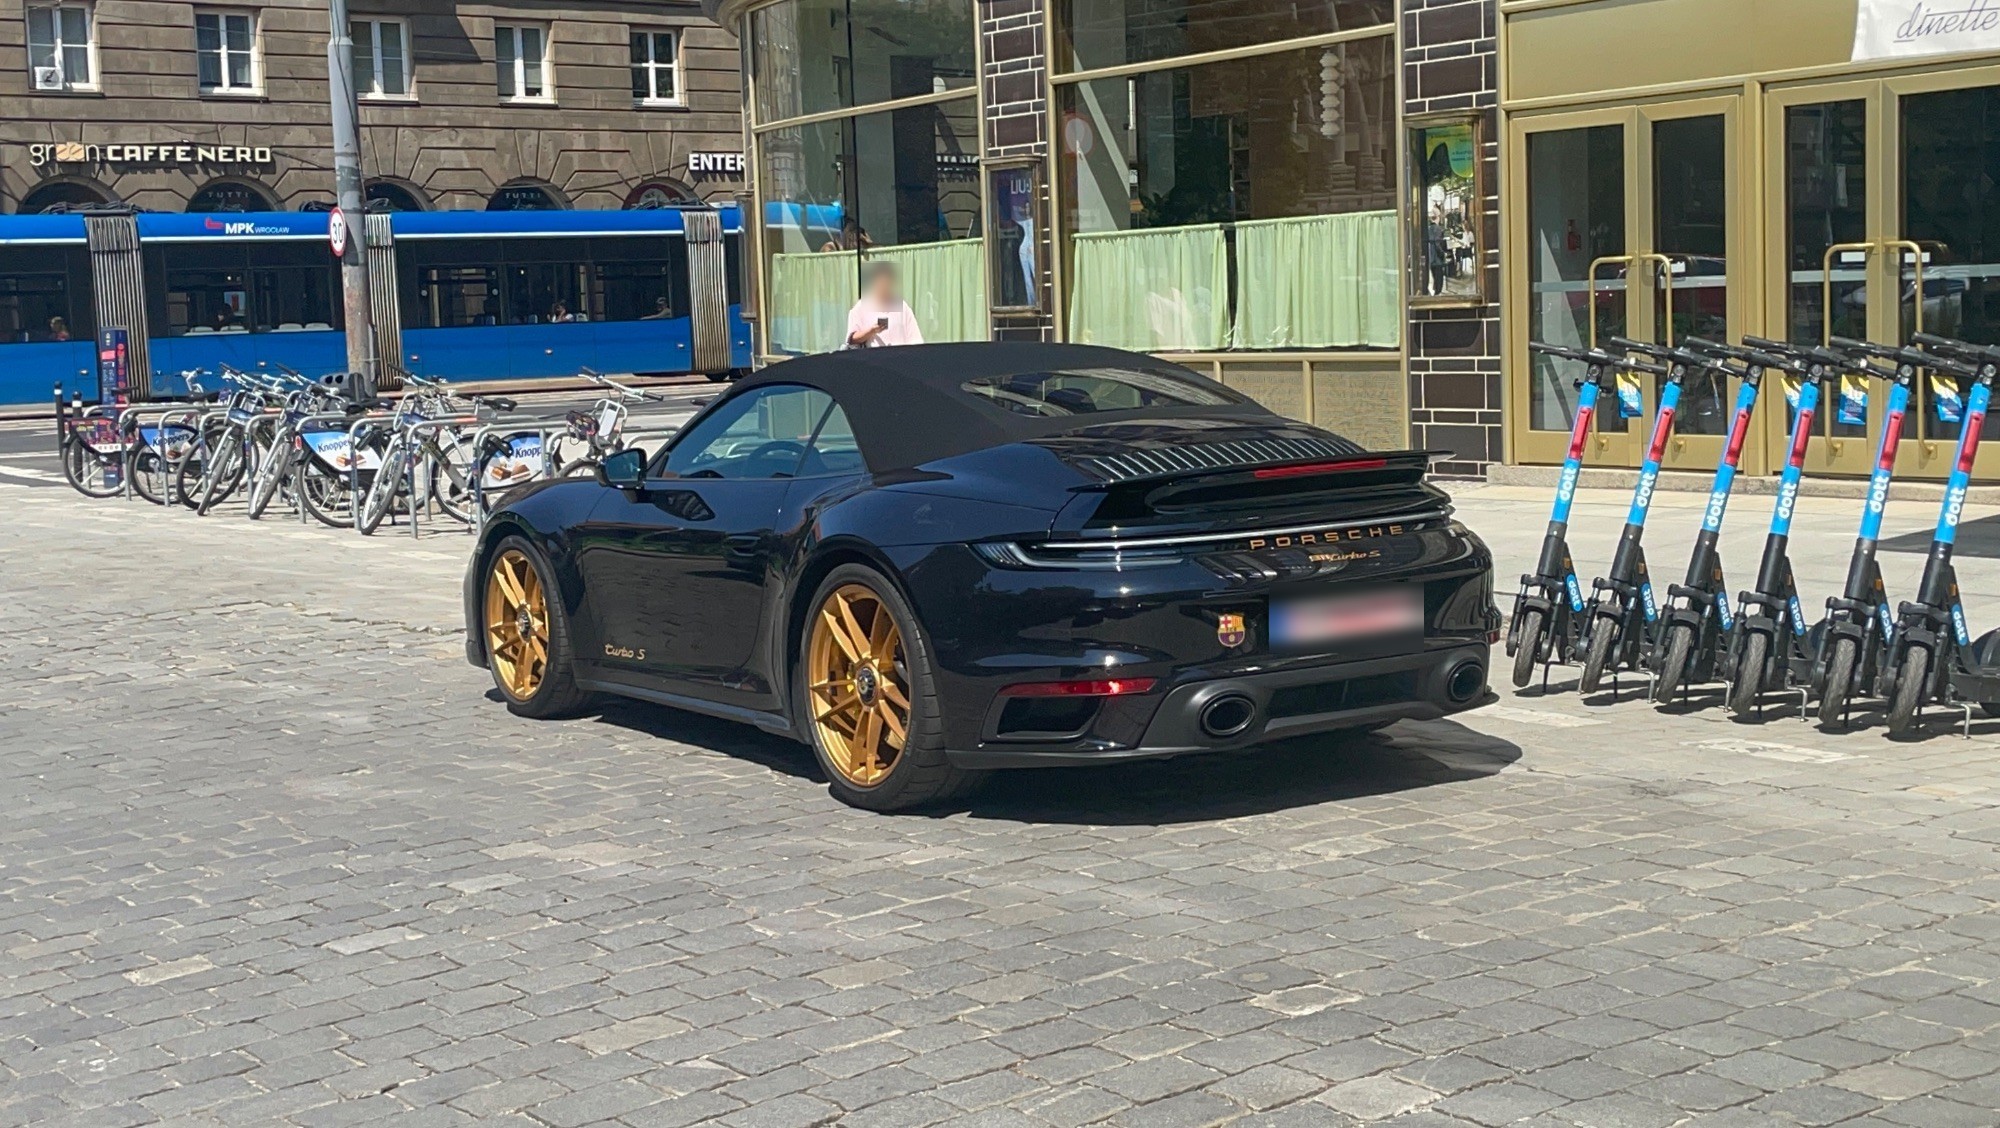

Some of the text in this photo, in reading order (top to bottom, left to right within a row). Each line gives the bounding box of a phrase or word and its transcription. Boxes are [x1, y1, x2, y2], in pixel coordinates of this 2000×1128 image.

[1896, 0, 2000, 38] dinette
[197, 146, 272, 162] NERO
[688, 153, 745, 171] ENTER
[225, 222, 255, 234] MPK
[332, 223, 343, 244] 30
[152, 433, 190, 447] Koppers
[515, 446, 542, 458] Knopp
[1558, 467, 1577, 501] dott
[1636, 473, 1655, 507] dott
[1869, 475, 1890, 513] dott
[1706, 491, 1726, 527] dott
[1778, 482, 1797, 519] dott
[1944, 487, 1965, 527] dott
[1250, 525, 1403, 549] PORSCHE
[1568, 580, 1581, 606] dott
[1719, 598, 1731, 625] dott
[1791, 601, 1803, 629] dott
[1953, 610, 1966, 640] dott
[636, 648, 646, 660] S
